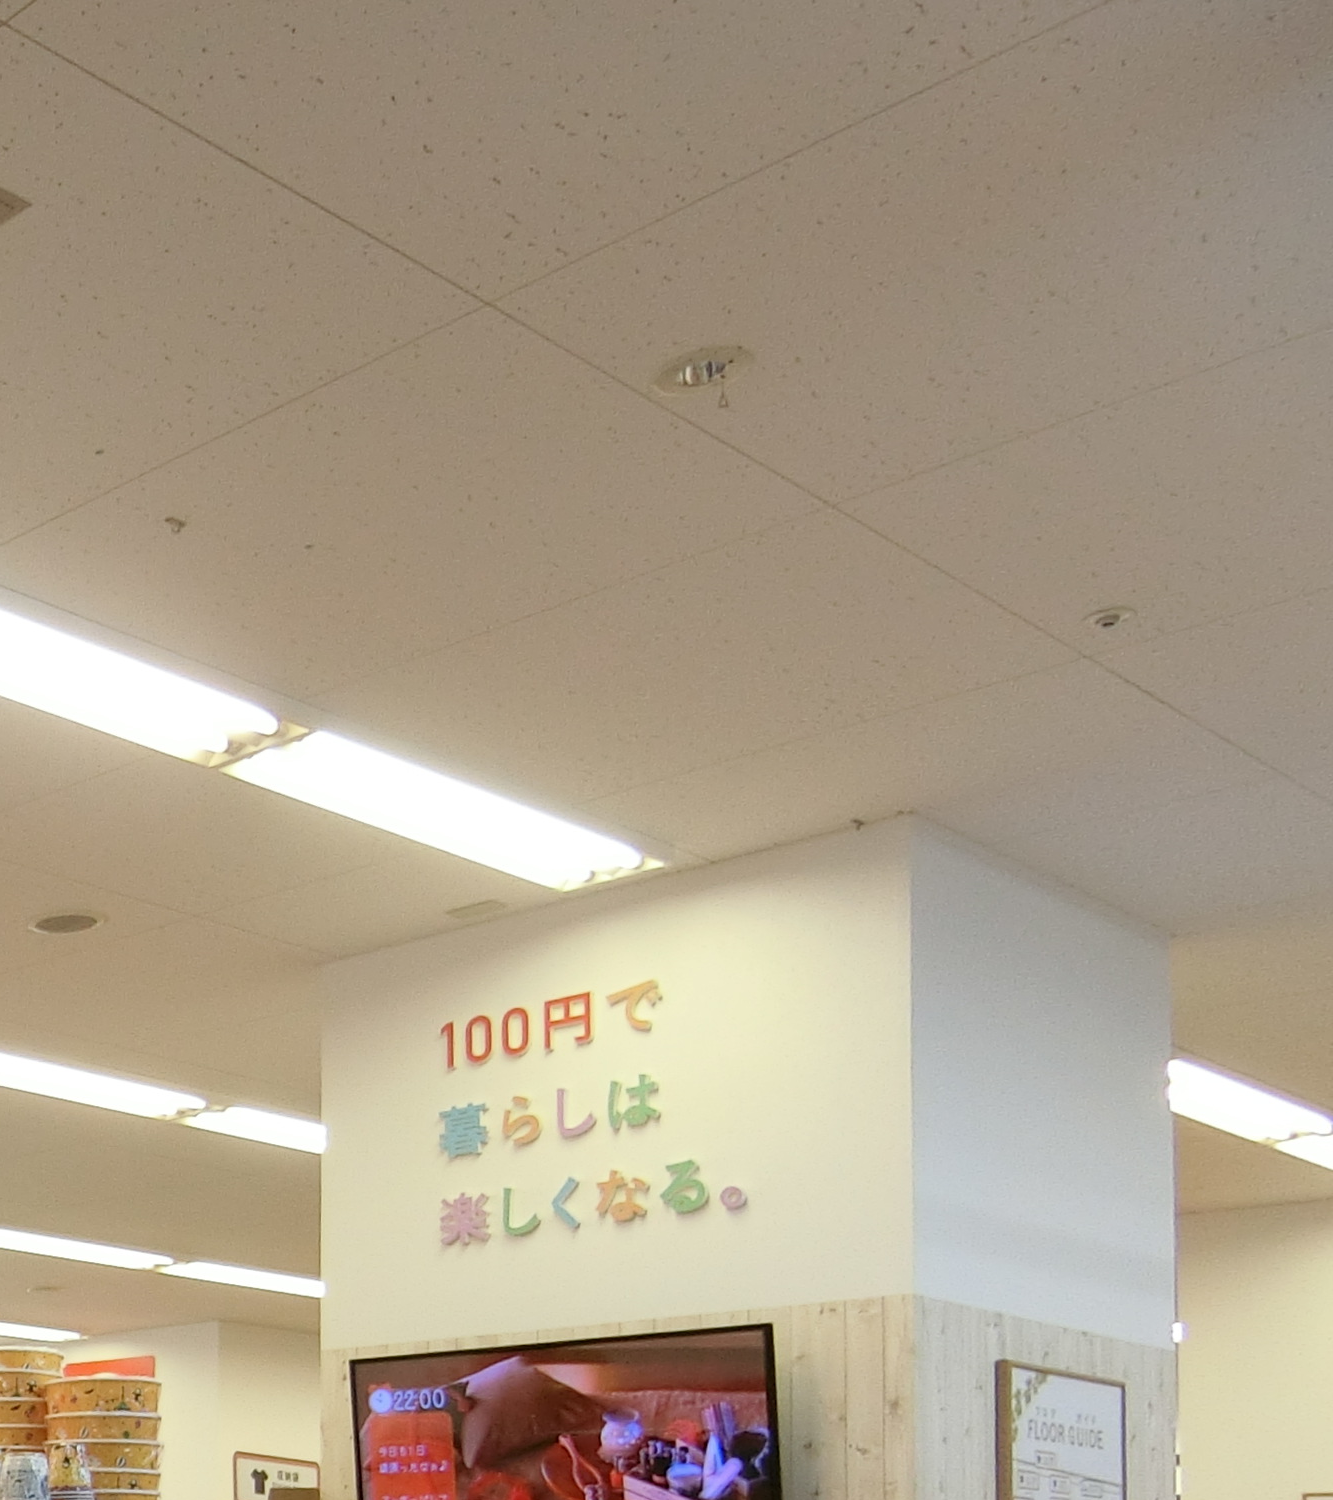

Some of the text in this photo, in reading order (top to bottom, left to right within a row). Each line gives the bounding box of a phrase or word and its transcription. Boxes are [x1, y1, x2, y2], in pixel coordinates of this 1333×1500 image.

[439, 978, 663, 1070] 100円で
[438, 1073, 661, 1159] 暮らしは
[439, 1159, 750, 1246] 楽しくなる。
[393, 1389, 445, 1411] 22:00
[1027, 1419, 1104, 1450] FLOOR GUIDE
